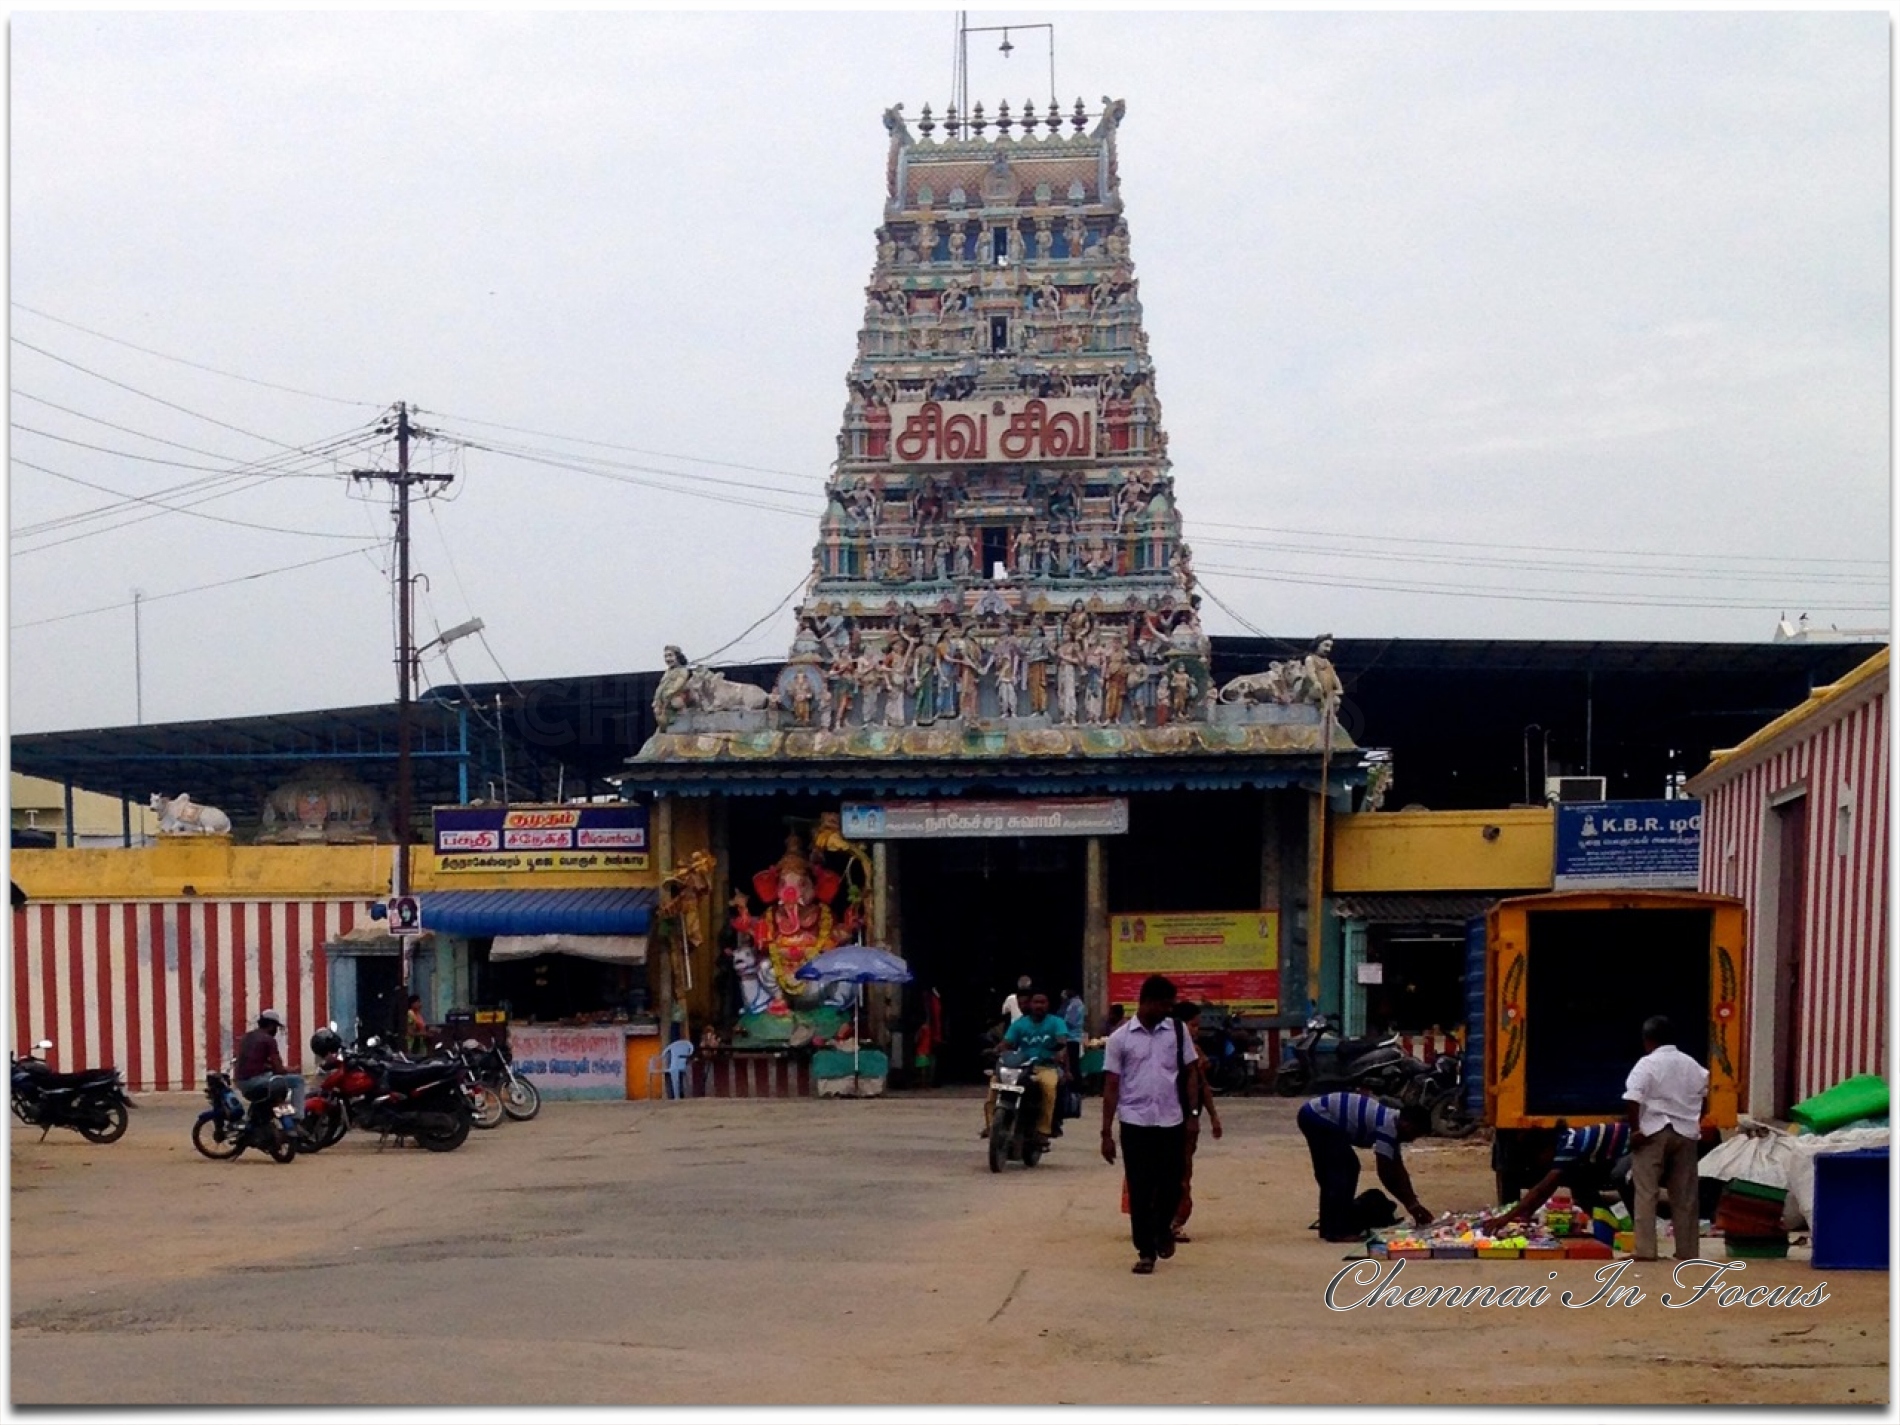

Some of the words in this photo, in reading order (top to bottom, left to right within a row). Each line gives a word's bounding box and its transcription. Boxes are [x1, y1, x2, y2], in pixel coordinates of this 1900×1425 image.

[895, 400, 988, 461] சிவ
[999, 399, 1091, 459] சிவ
[507, 811, 575, 828] குமுதம்
[1007, 811, 1061, 828] சுவாமி
[1602, 817, 1665, 832] K.B.R.
[526, 857, 553, 873] பூஜை
